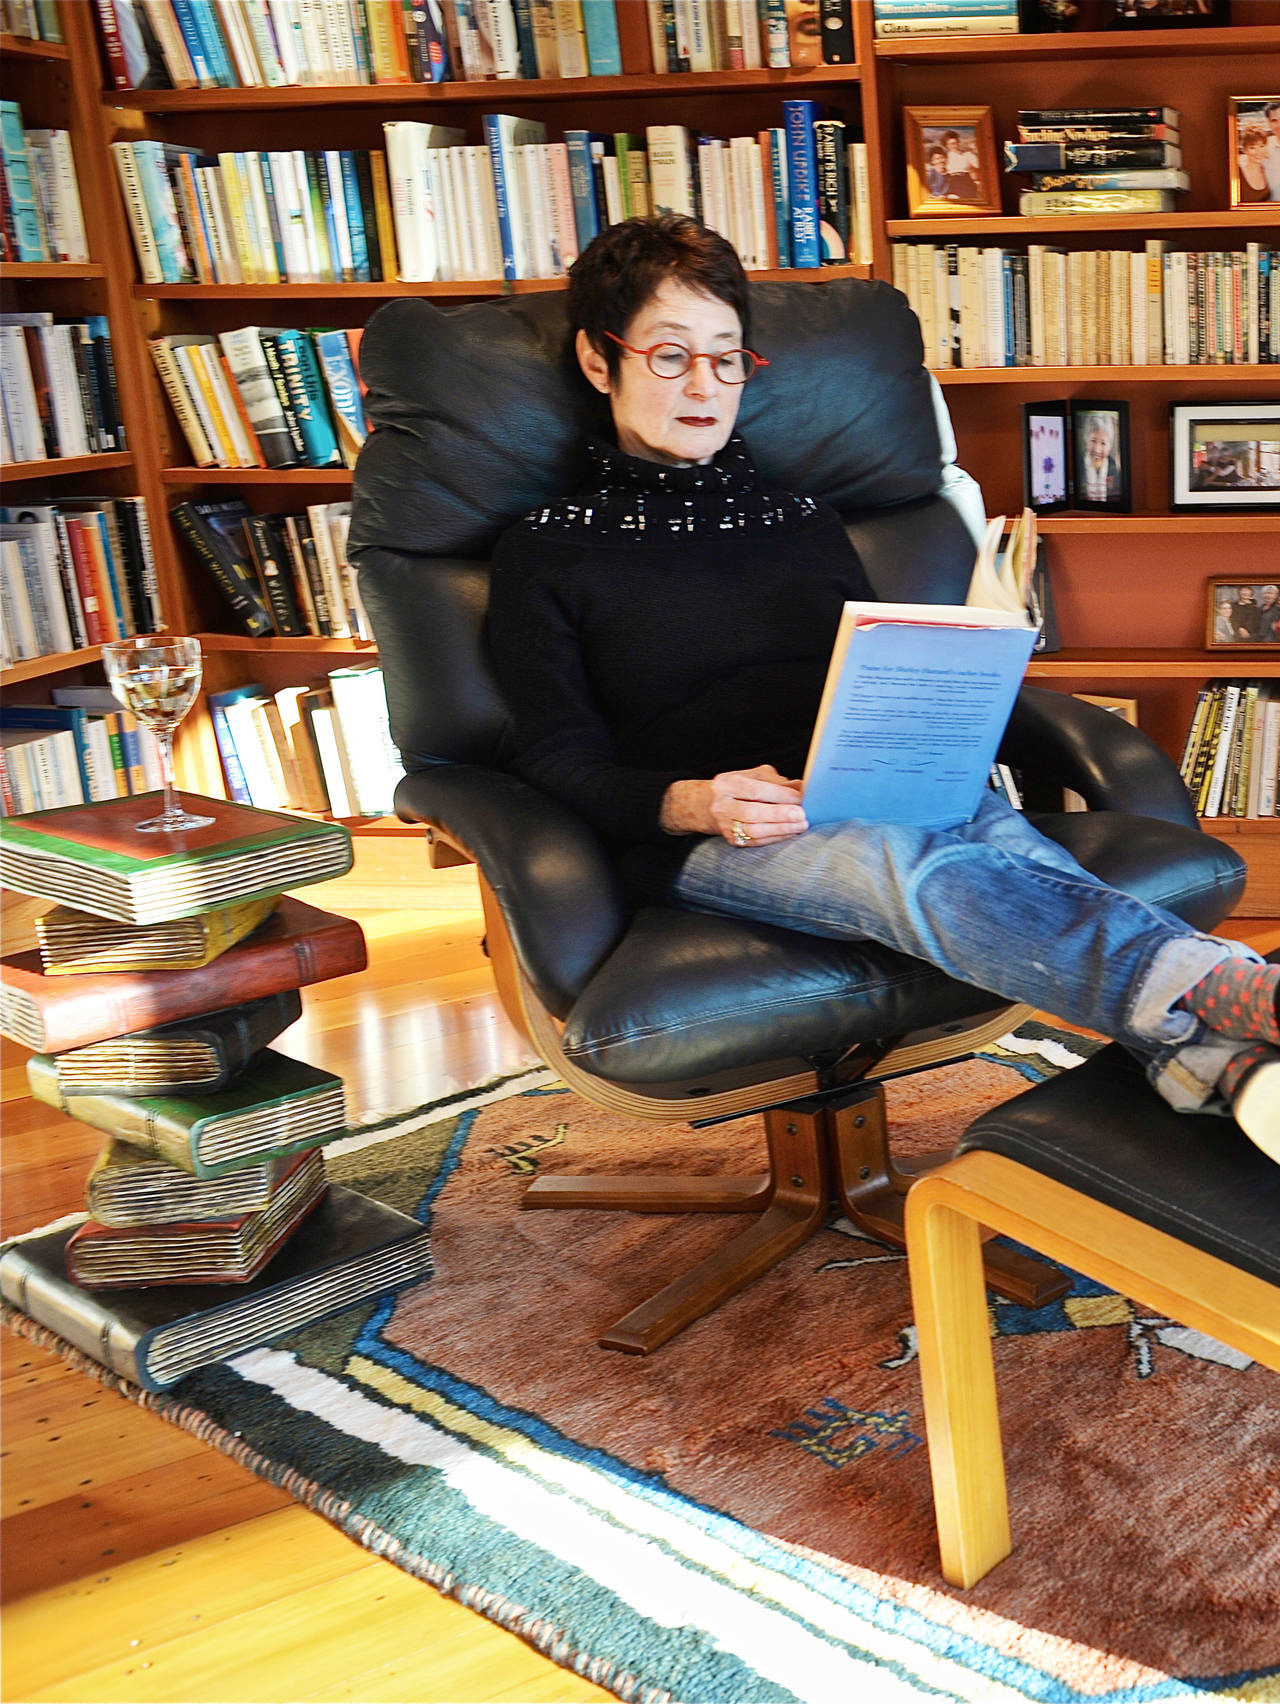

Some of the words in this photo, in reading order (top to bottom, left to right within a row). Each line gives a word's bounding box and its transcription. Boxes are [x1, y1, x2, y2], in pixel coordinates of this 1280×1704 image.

[788, 106, 806, 147] JOHN
[822, 127, 836, 161] RABBIT
[792, 150, 811, 201] UPDIKE
[825, 172, 838, 196] RICH
[296, 337, 315, 373] Leon
[279, 340, 313, 422] TRINITY
[303, 374, 322, 402] Uris
[175, 510, 194, 528] THE
[188, 529, 213, 560] NIGHT
[210, 561, 237, 594] WATCH
